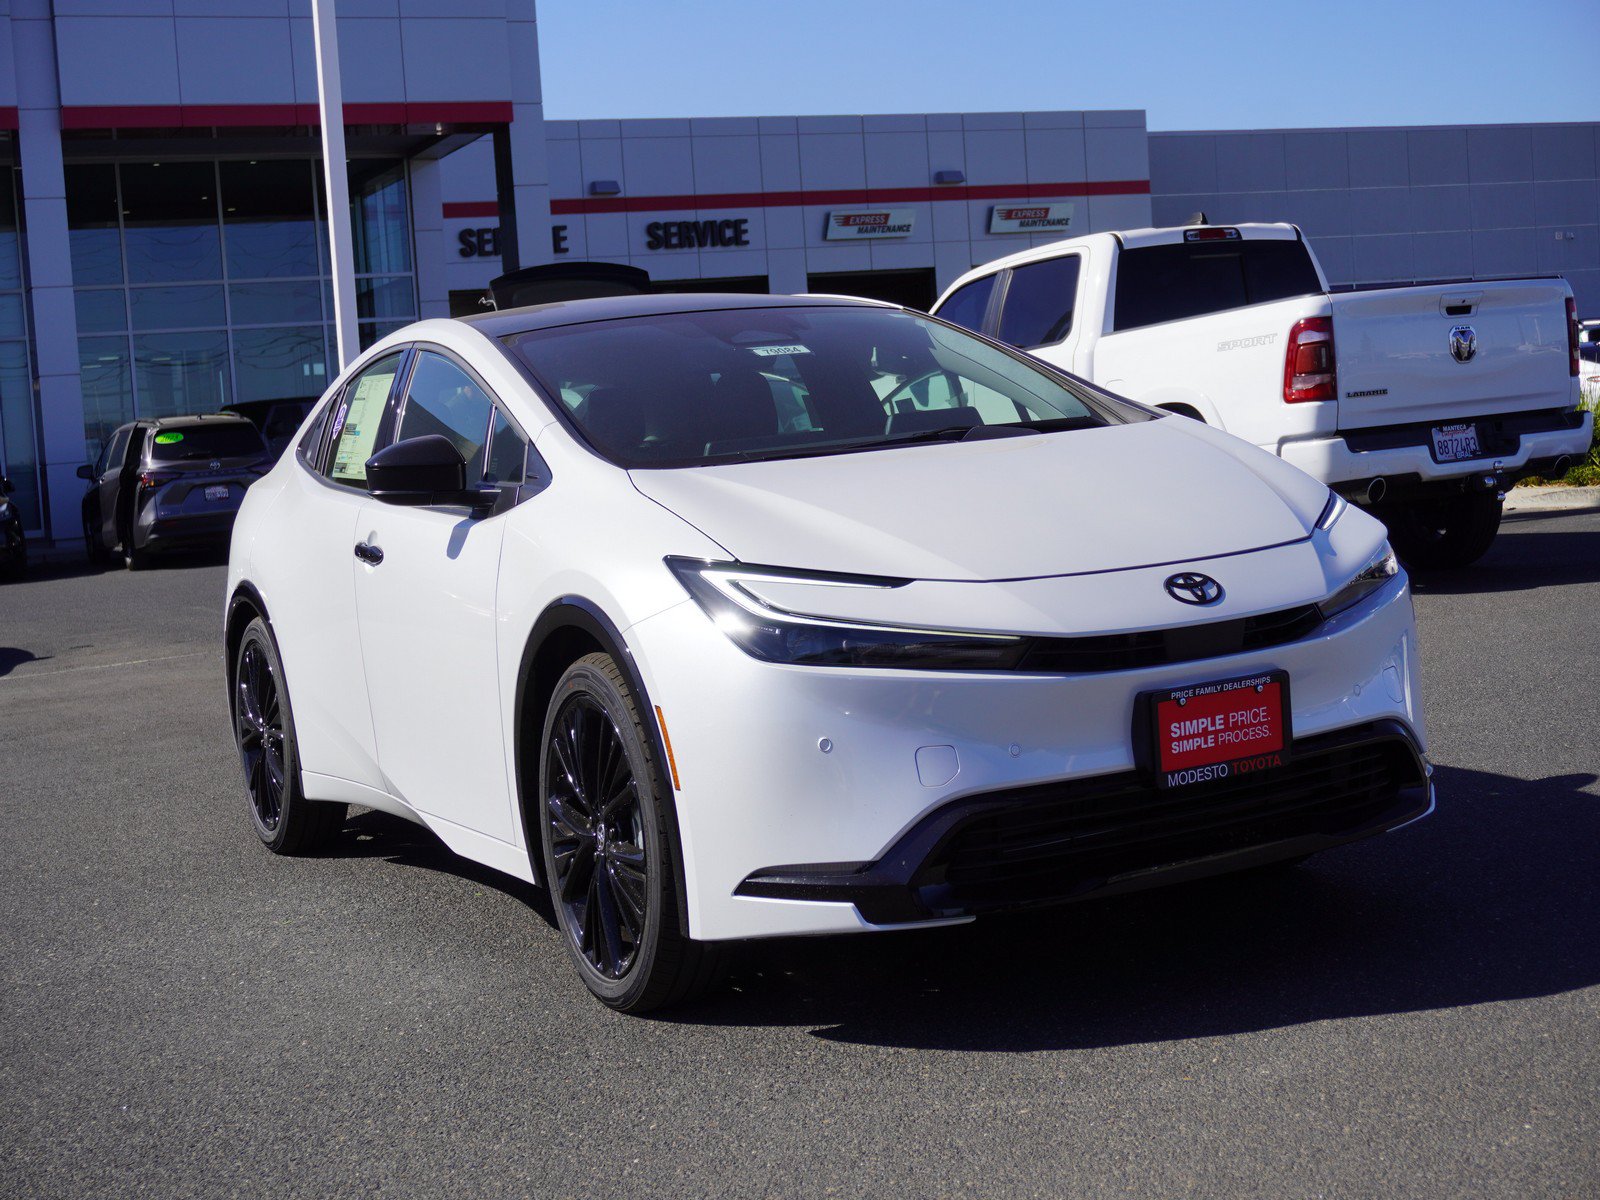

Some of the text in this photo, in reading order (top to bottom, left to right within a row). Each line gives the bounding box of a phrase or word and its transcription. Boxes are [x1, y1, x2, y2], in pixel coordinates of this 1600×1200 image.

[849, 215, 886, 225] EXPRESS
[1011, 209, 1046, 219] EXPRESS
[1019, 217, 1070, 228] MAINTENANCE
[646, 218, 750, 250] SERVICE
[857, 224, 912, 234] MAINTENANCE
[1217, 332, 1278, 352] SPORT
[1442, 424, 1467, 432] MANTECA
[1171, 676, 1271, 700] PRICE FAMILY DEALERSHIPS
[1170, 706, 1271, 738] SIMPLE PRICE.
[1171, 725, 1272, 754] SIMPLE PROCESS.
[1168, 754, 1282, 787] MODESTO TOYOTA
